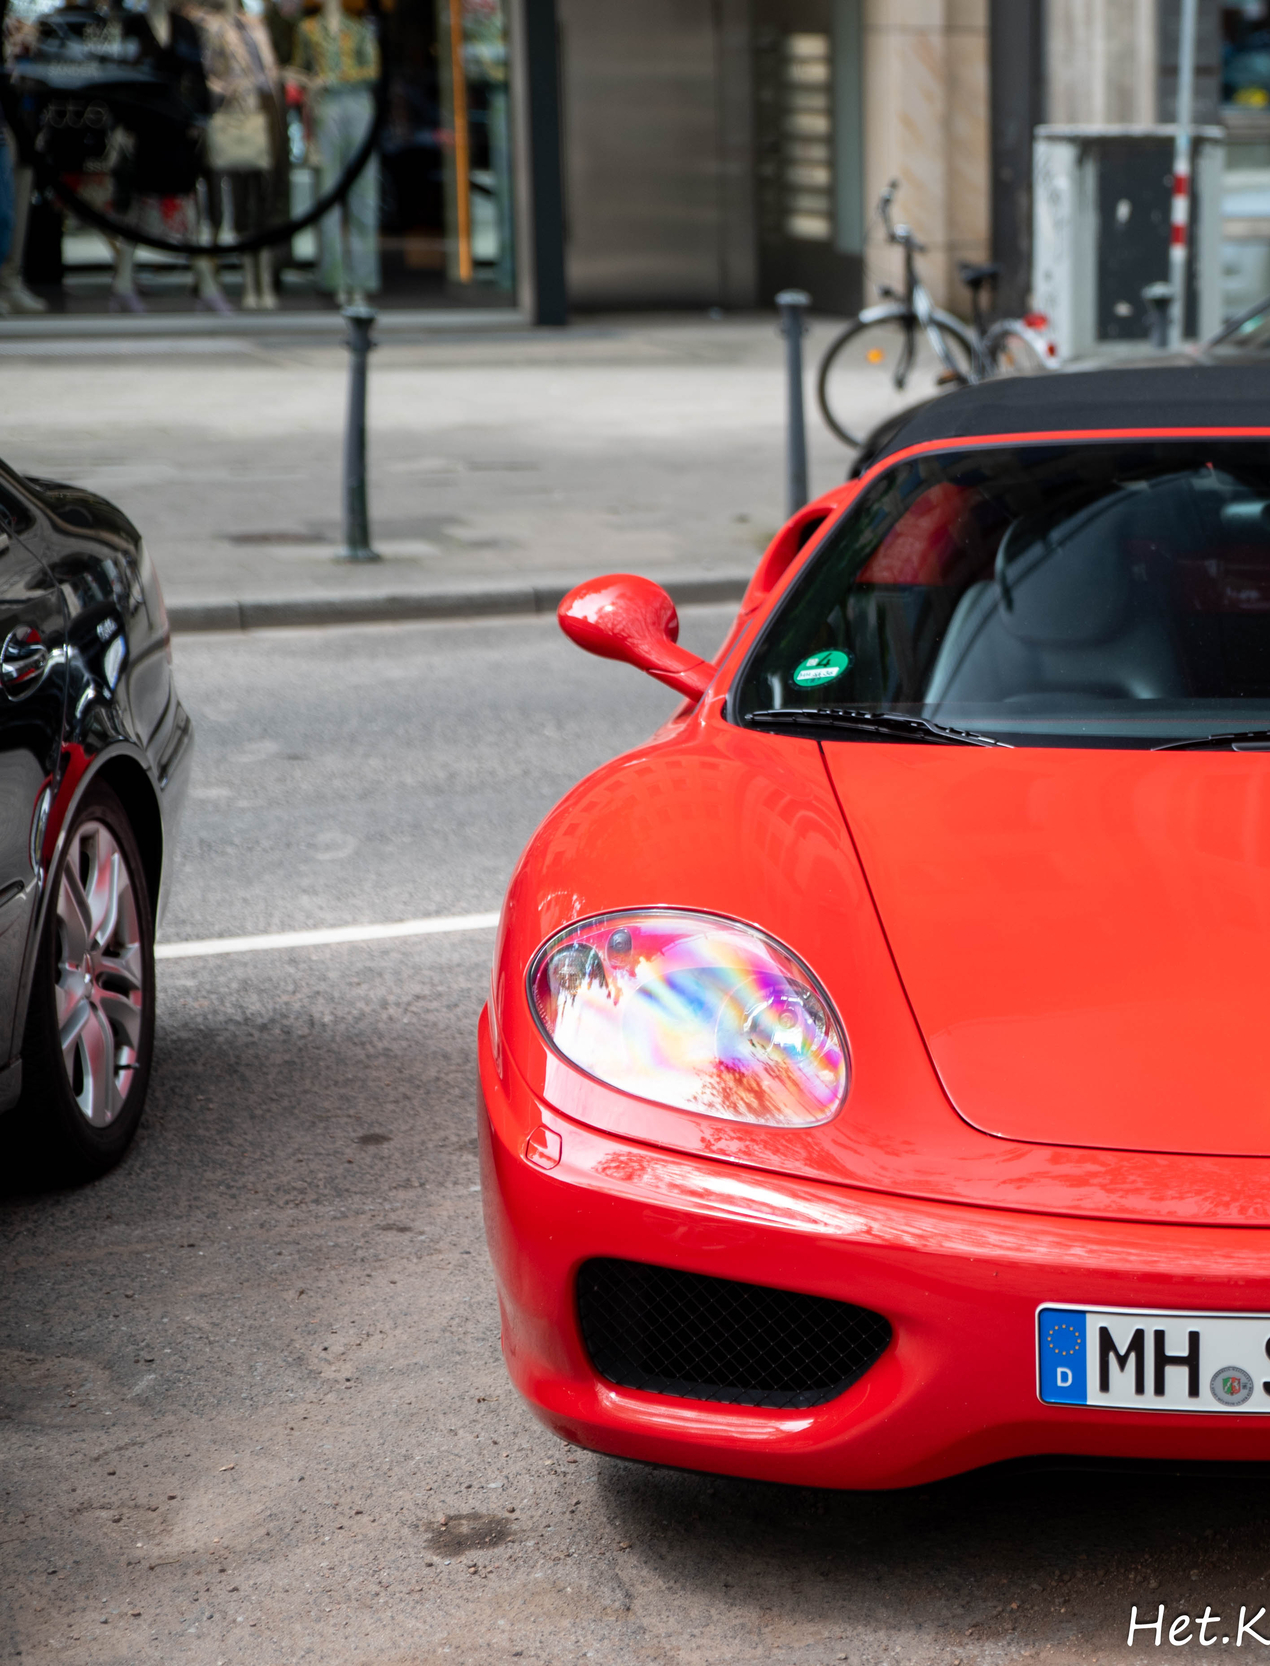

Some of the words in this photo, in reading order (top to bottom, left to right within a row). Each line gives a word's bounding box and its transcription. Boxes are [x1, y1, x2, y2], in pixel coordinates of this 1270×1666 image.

[816, 652, 832, 667] 4
[1098, 1325, 1201, 1397] MH
[1056, 1366, 1073, 1387] D
